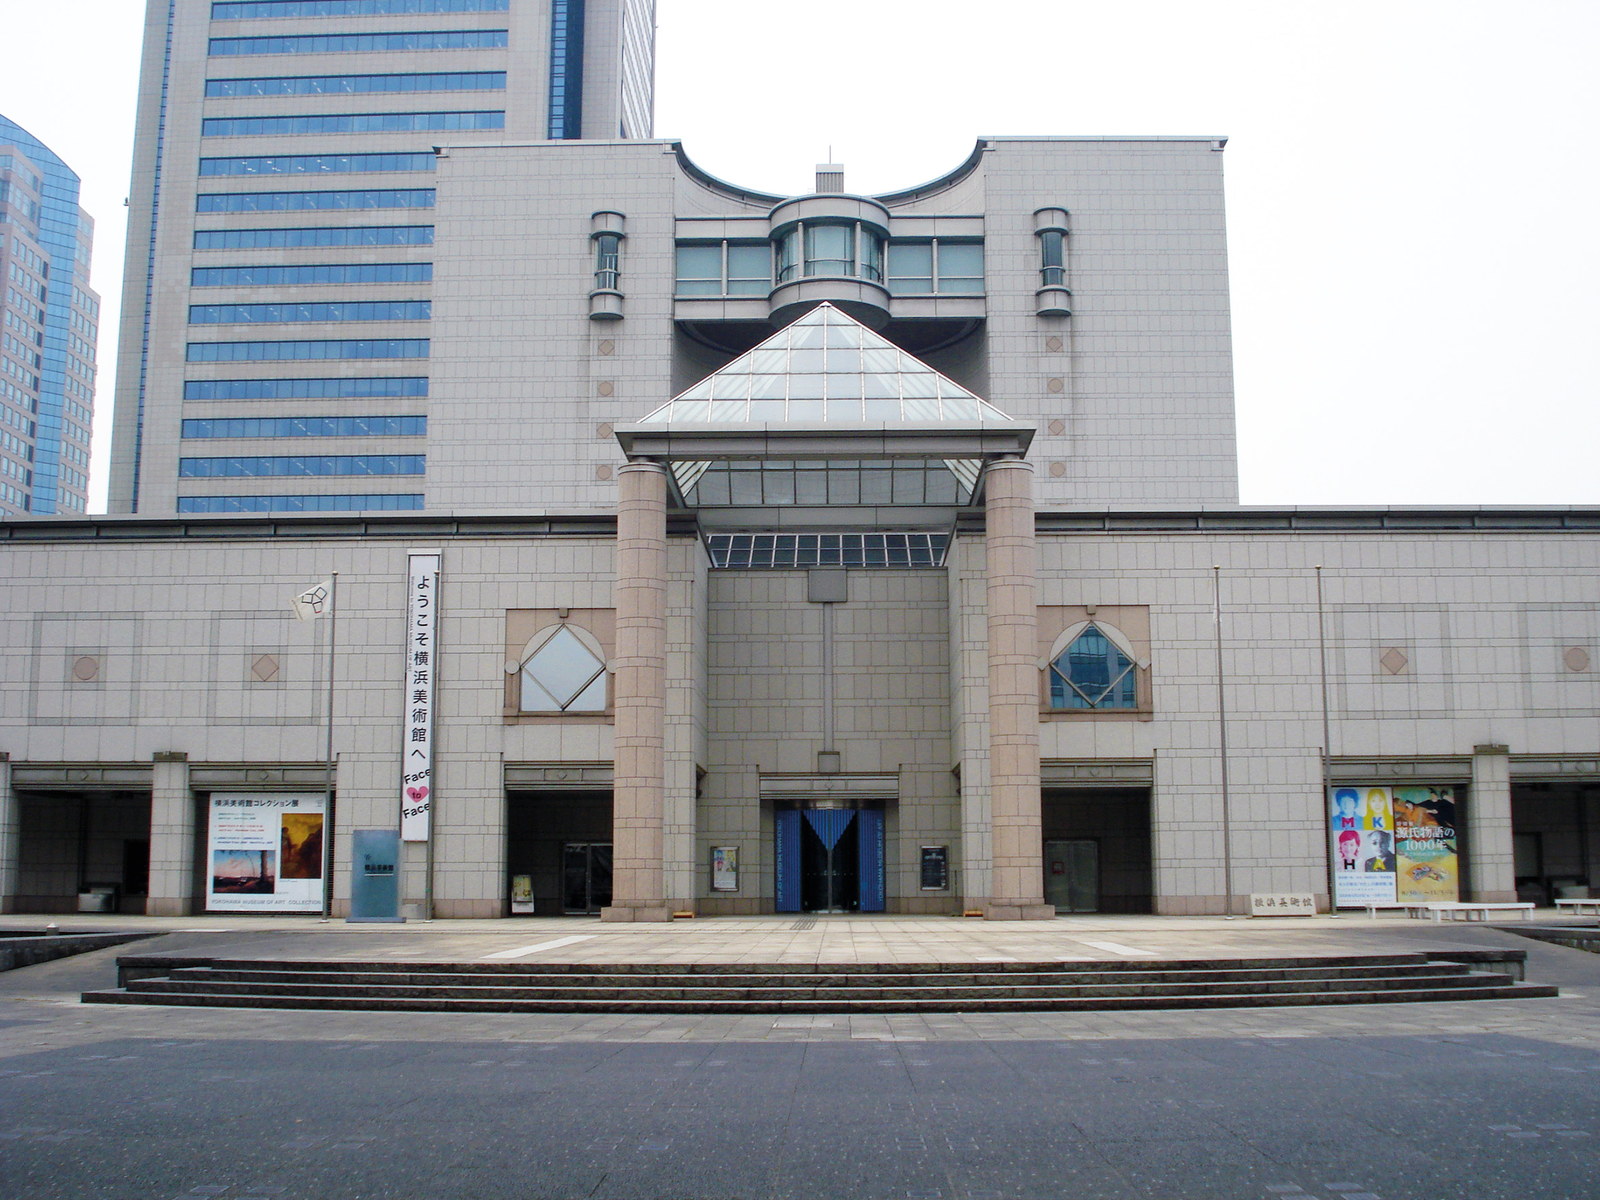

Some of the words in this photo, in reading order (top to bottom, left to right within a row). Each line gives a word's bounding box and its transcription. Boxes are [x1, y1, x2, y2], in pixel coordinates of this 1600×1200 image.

[411, 576, 430, 760] ようこそ横浜美術館へ
[404, 769, 430, 784] Face
[214, 799, 299, 808] 横浜美術館コレクション展
[402, 803, 430, 819] Face
[1341, 816, 1355, 828] M
[1372, 816, 1384, 828] K
[1395, 826, 1455, 838] 源氏物語の
[1404, 838, 1448, 851] 1000年
[1343, 858, 1355, 870] H
[1374, 858, 1386, 871] A
